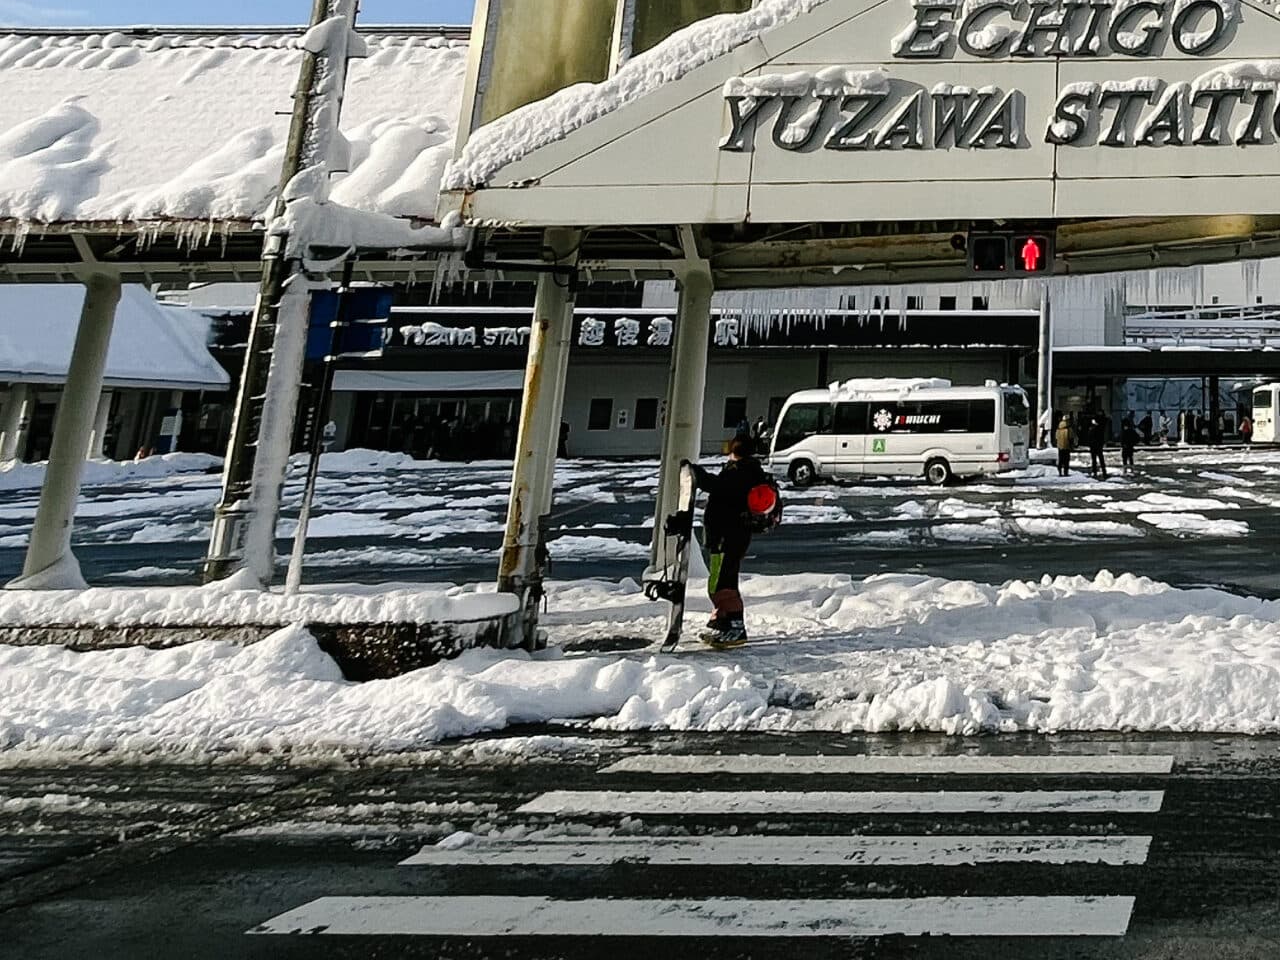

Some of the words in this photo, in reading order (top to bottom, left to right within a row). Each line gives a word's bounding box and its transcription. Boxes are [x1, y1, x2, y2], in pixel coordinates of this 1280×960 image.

[719, 90, 1021, 151] YUZAWA
[483, 326, 531, 345] STAT
[578, 317, 738, 346] 越後湯駅
